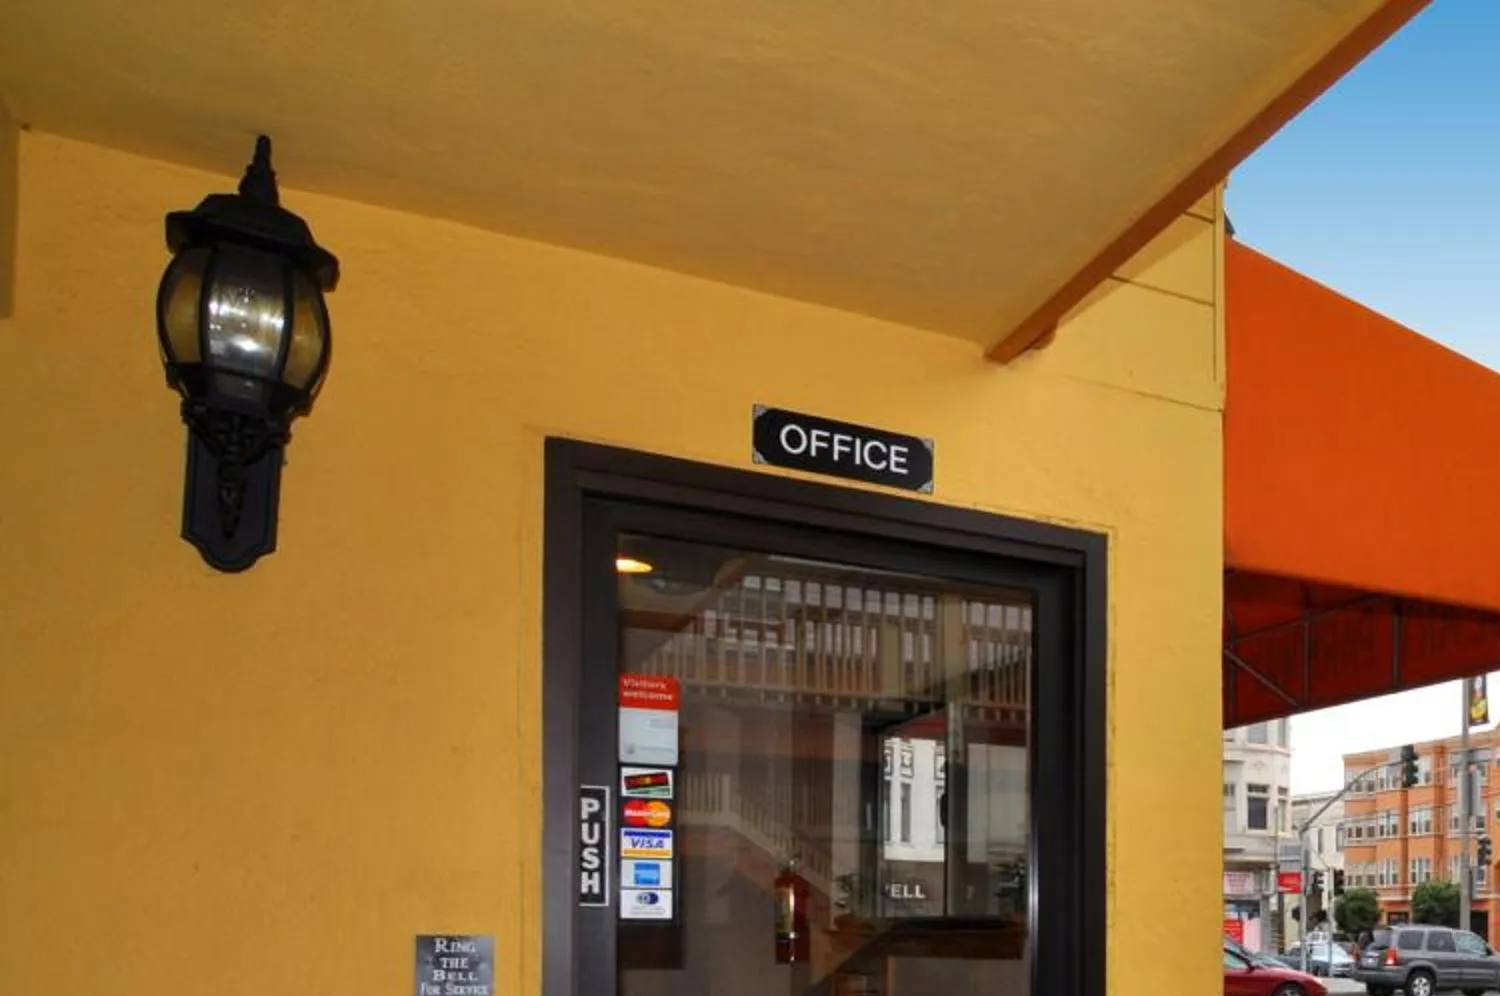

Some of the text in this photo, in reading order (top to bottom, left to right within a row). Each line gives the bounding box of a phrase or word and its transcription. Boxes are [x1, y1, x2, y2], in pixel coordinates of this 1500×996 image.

[780, 424, 909, 474] OFFICE
[623, 678, 667, 689] Visitors
[623, 691, 673, 701] welcome
[580, 798, 600, 895] PUSH
[631, 837, 665, 849] VISA
